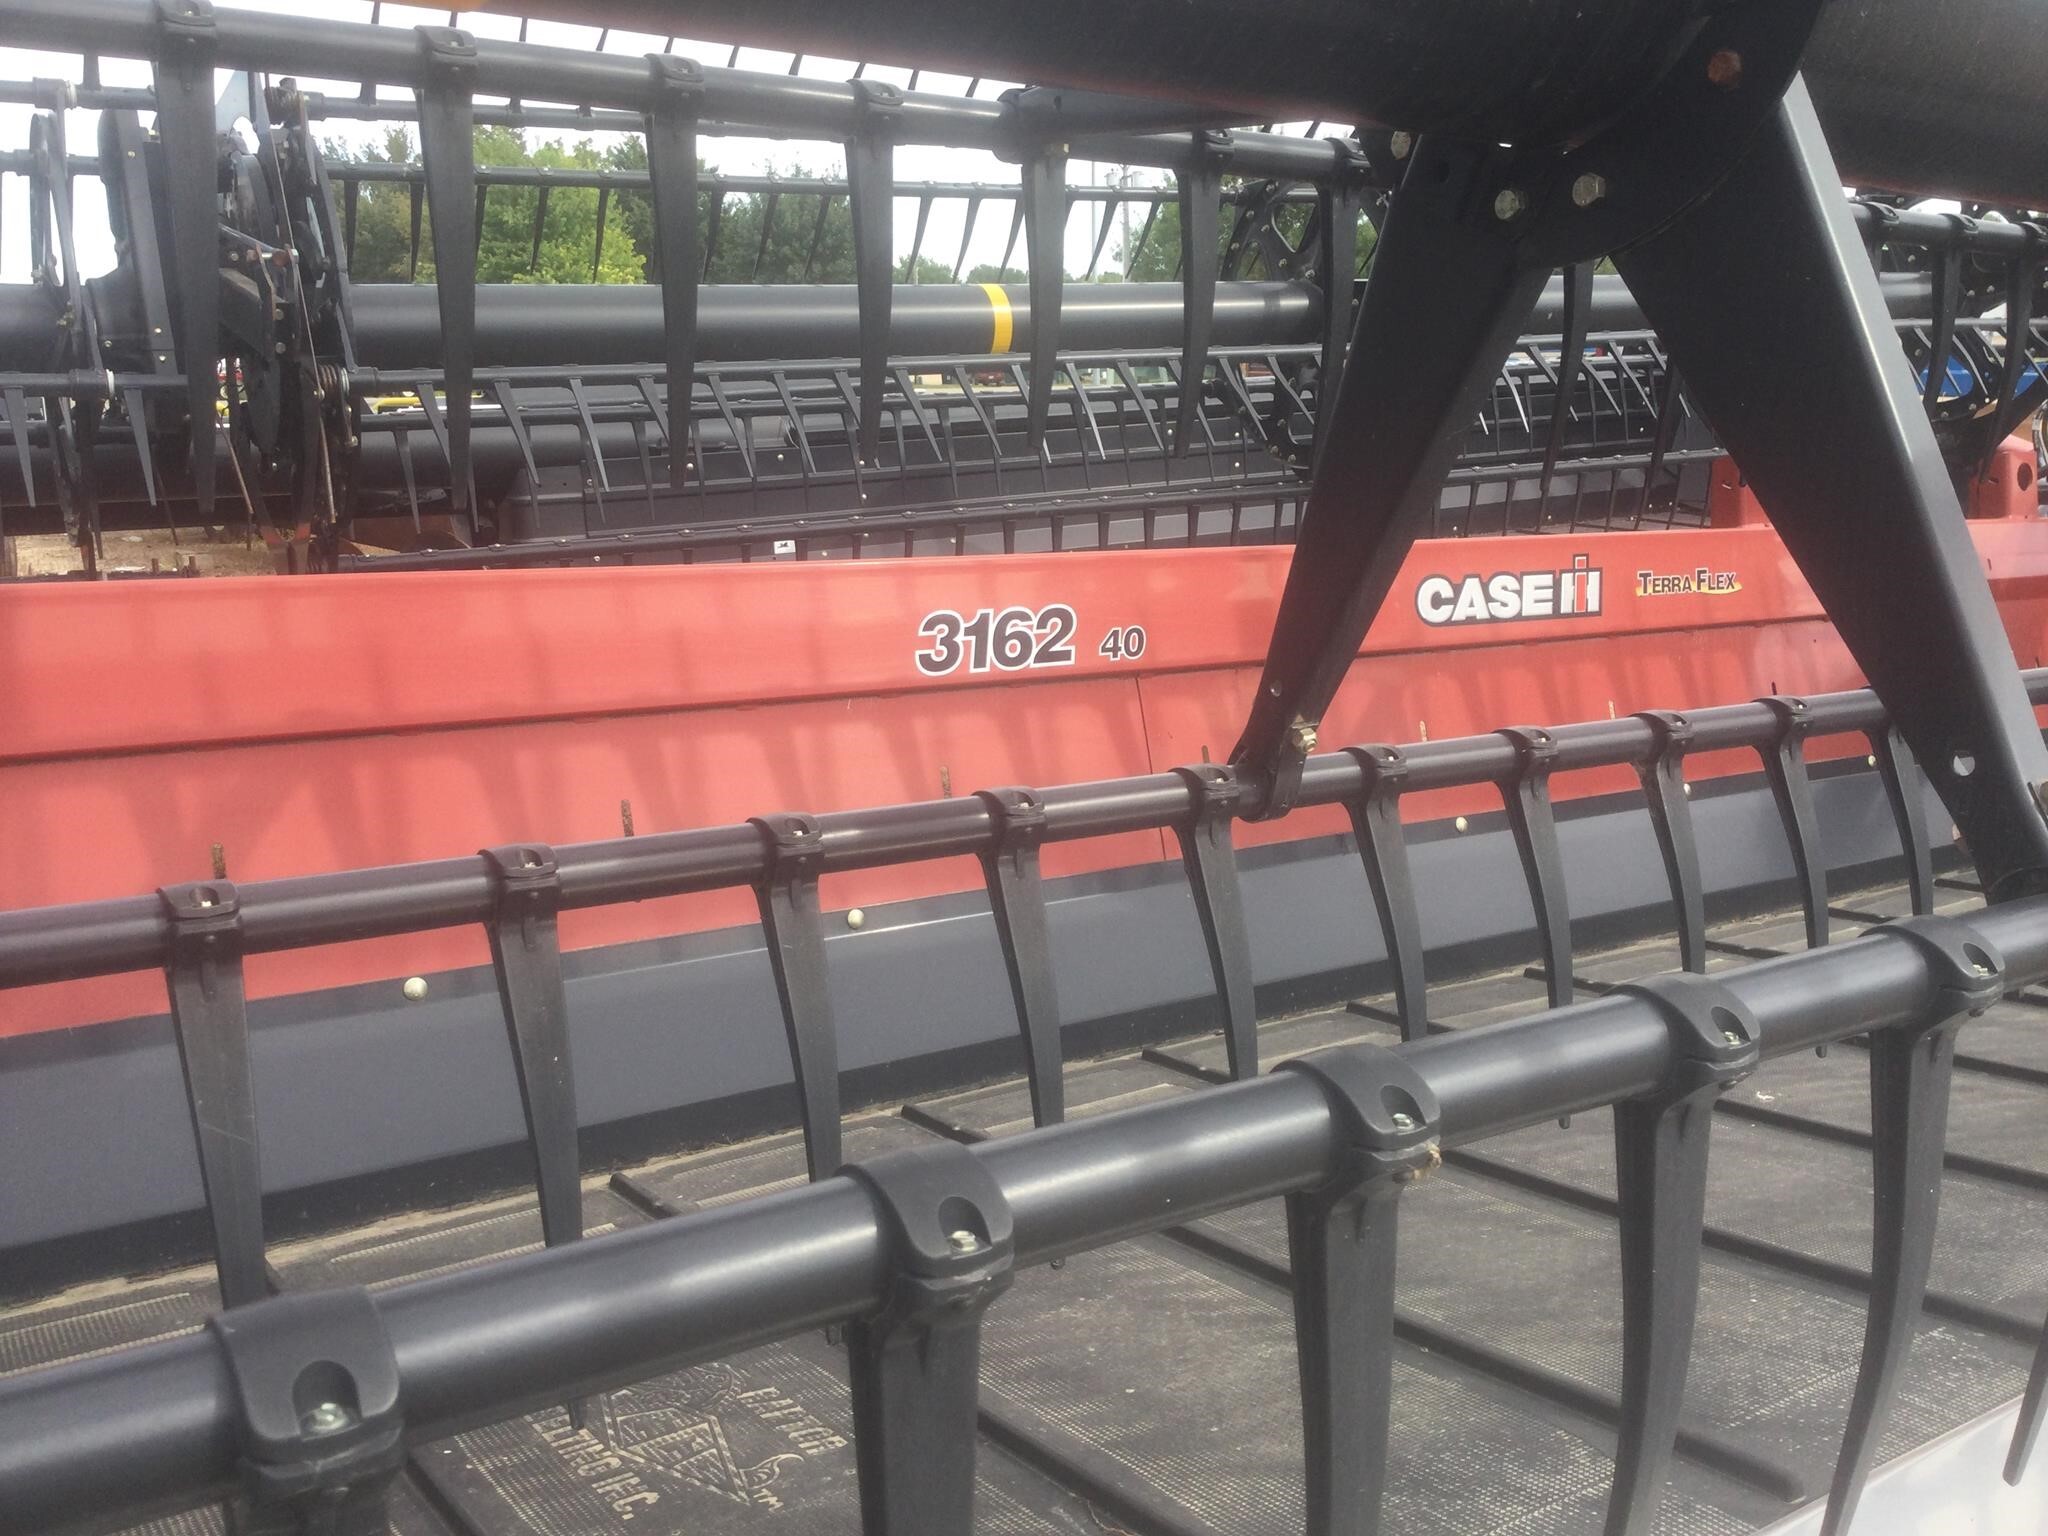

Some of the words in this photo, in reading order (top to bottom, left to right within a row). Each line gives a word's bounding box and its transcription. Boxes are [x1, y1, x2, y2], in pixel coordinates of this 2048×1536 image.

[1416, 573, 1555, 624] CASE
[1638, 571, 1693, 595] TERRA
[1695, 568, 1737, 594] FLEX
[915, 603, 1077, 676] 3162
[1099, 625, 1146, 661] 40
